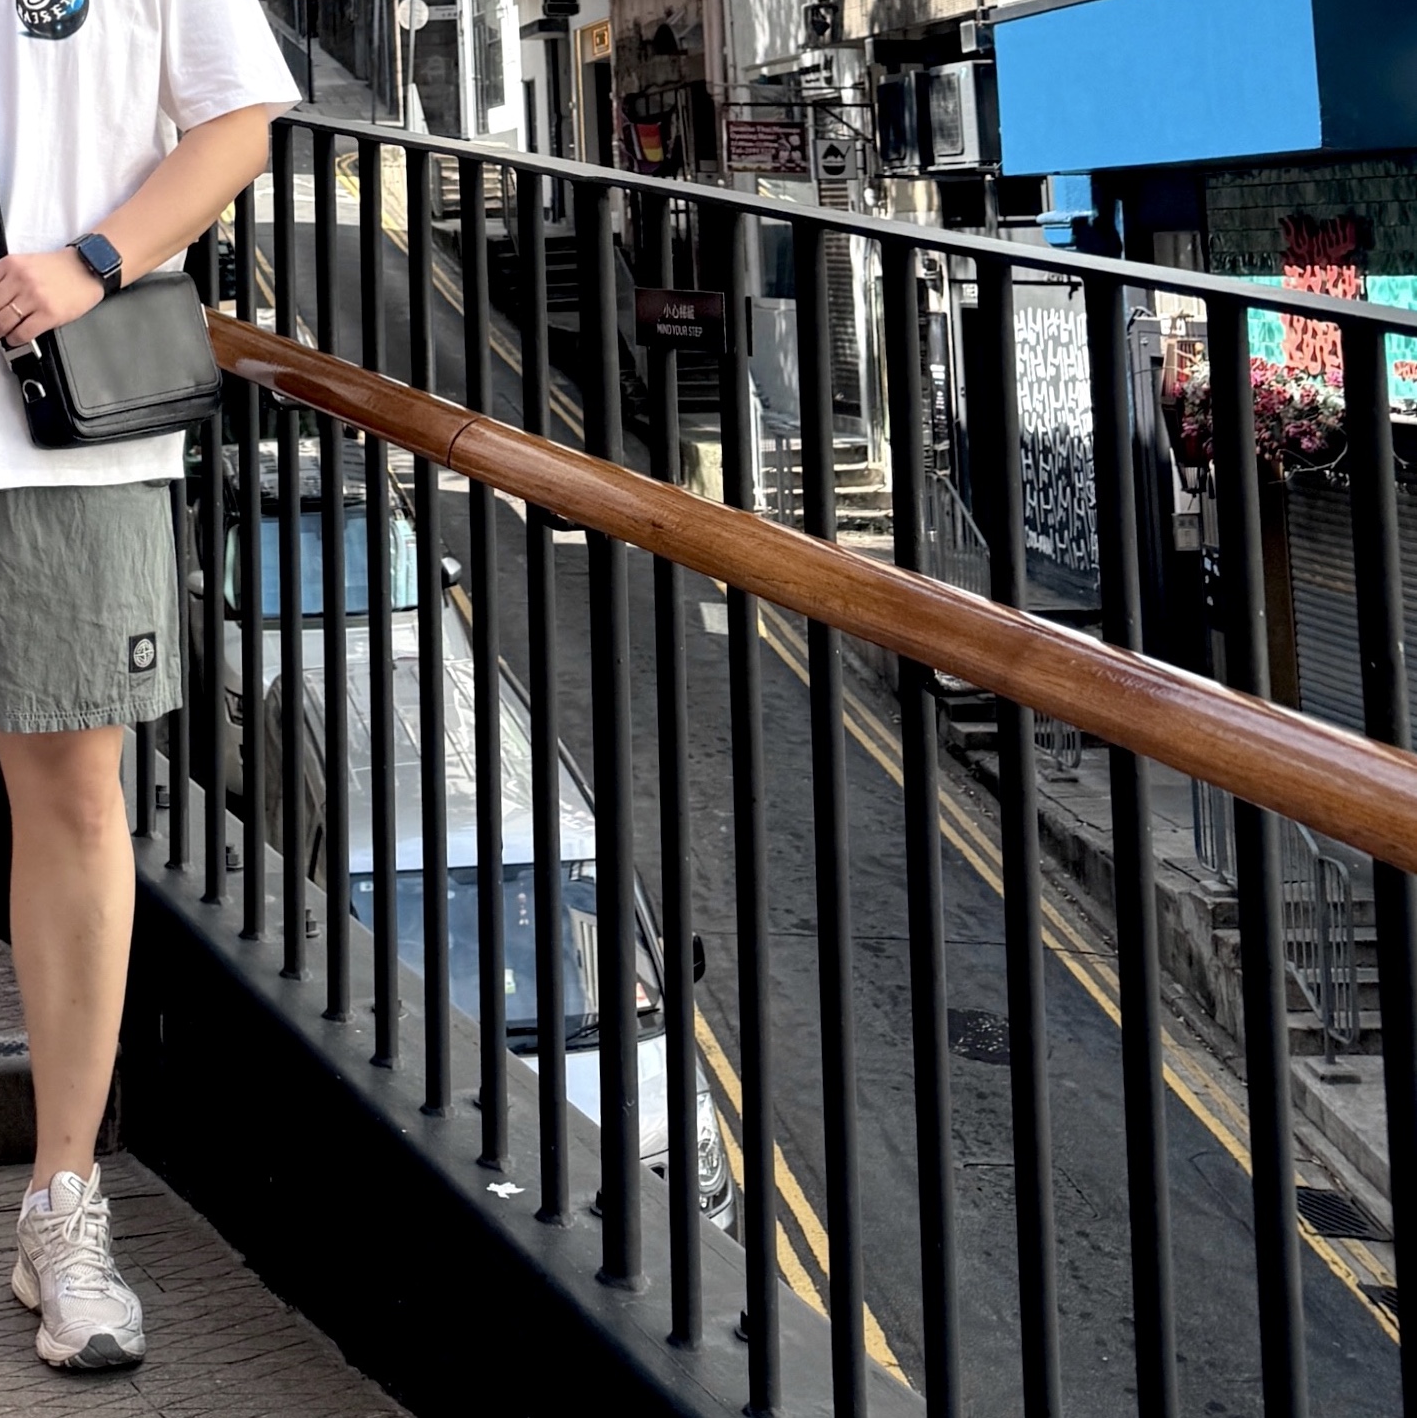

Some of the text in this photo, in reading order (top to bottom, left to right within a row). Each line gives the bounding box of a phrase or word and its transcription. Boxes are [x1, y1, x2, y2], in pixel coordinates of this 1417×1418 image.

[656, 323, 702, 337] MIND YOUR STEP
